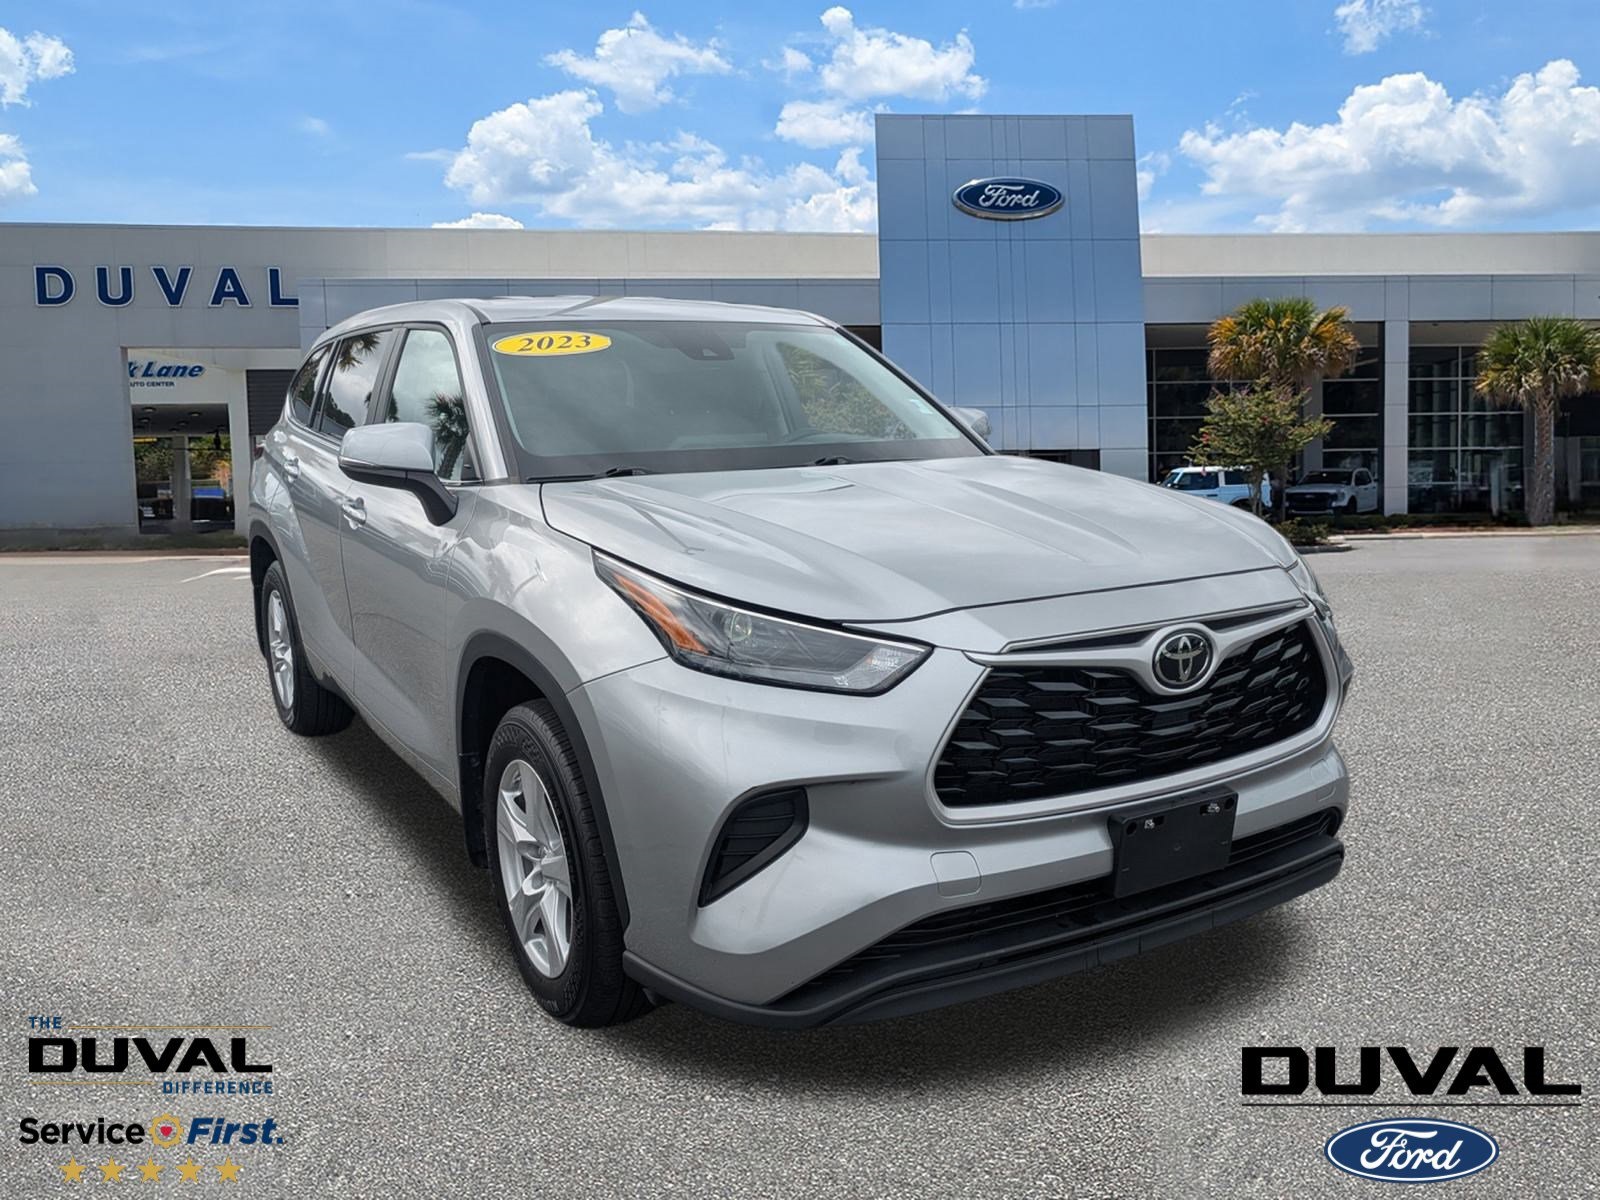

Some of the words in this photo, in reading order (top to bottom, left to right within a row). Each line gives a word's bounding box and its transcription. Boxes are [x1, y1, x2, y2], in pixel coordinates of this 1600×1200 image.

[978, 184, 1040, 207] Ford
[33, 265, 299, 307] DUVAL
[517, 335, 592, 352] 2023
[141, 361, 205, 378] Lane
